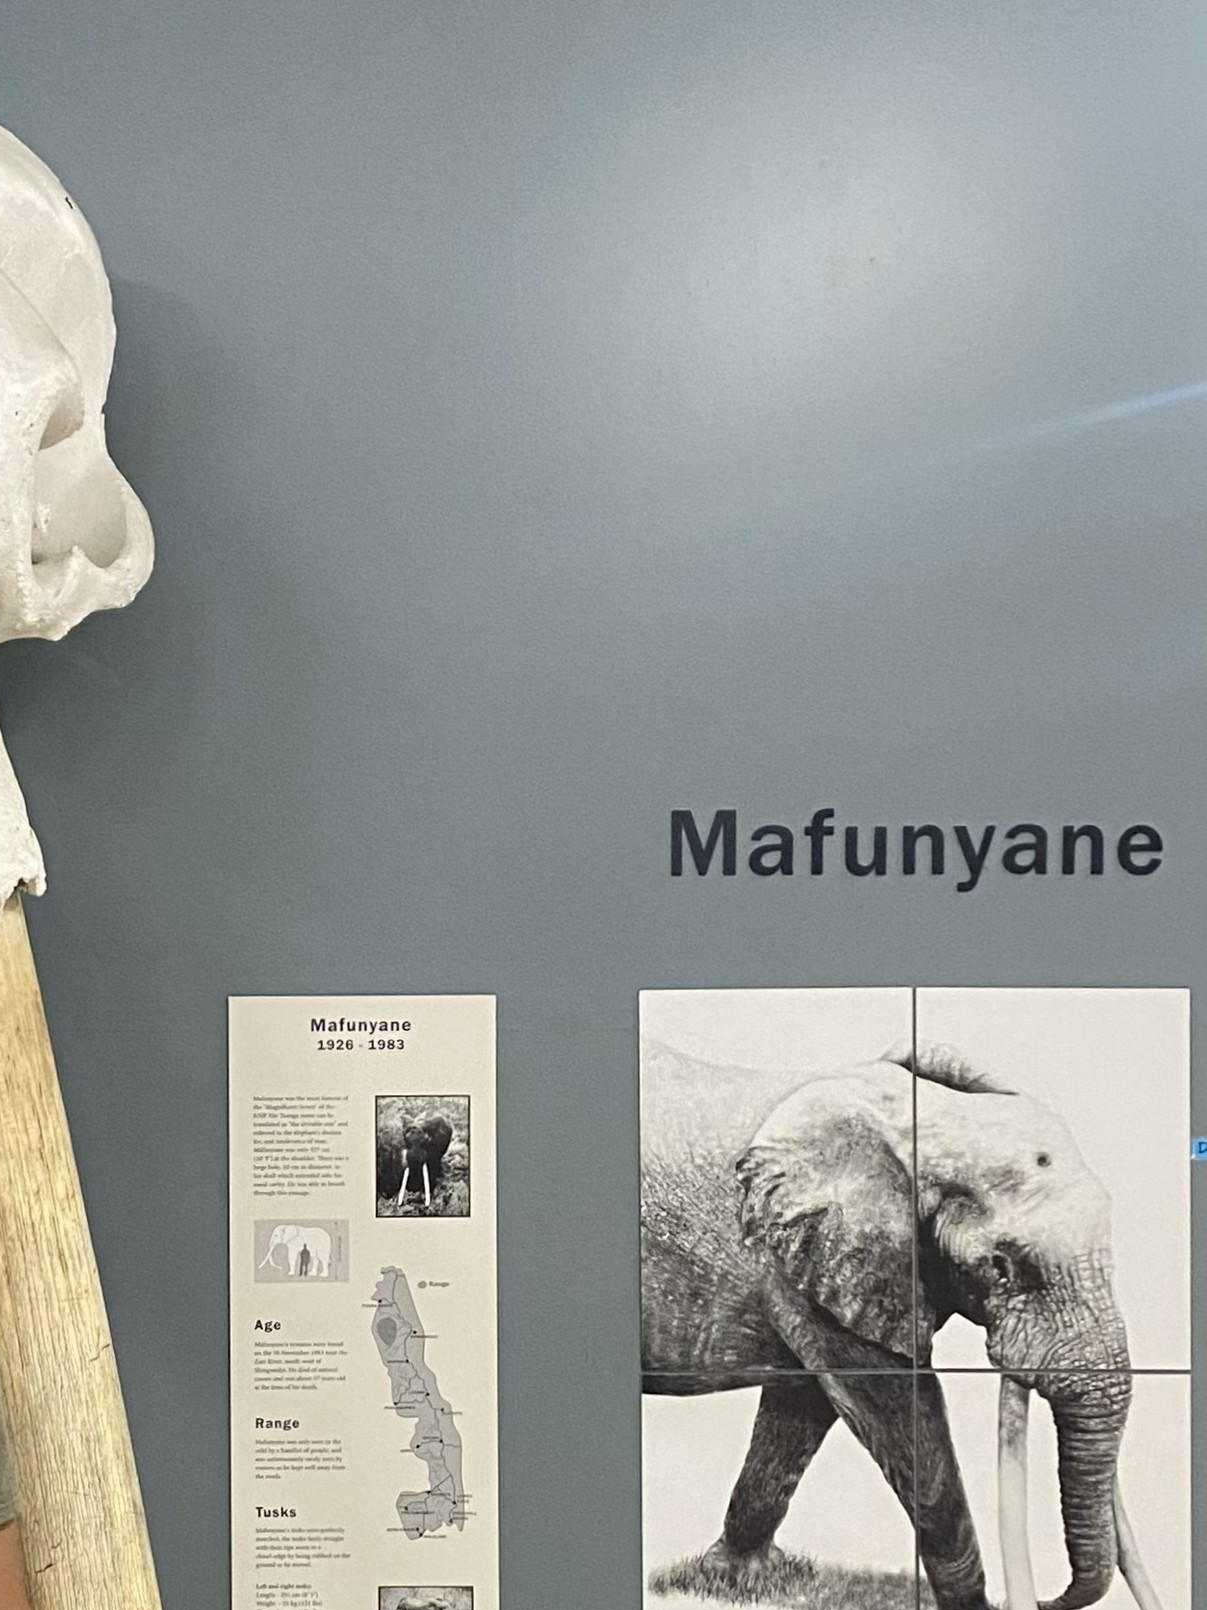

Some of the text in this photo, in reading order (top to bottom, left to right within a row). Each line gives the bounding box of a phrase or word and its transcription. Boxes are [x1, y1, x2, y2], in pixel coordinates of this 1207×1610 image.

[670, 807, 1164, 893] Mafunyane
[310, 1017, 412, 1034] Mafunyane
[317, 1039, 354, 1051] 1926
[368, 1039, 405, 1050] 1983
[254, 1319, 281, 1333] Age
[255, 1418, 300, 1431] Range
[255, 1506, 297, 1518] Tusks
